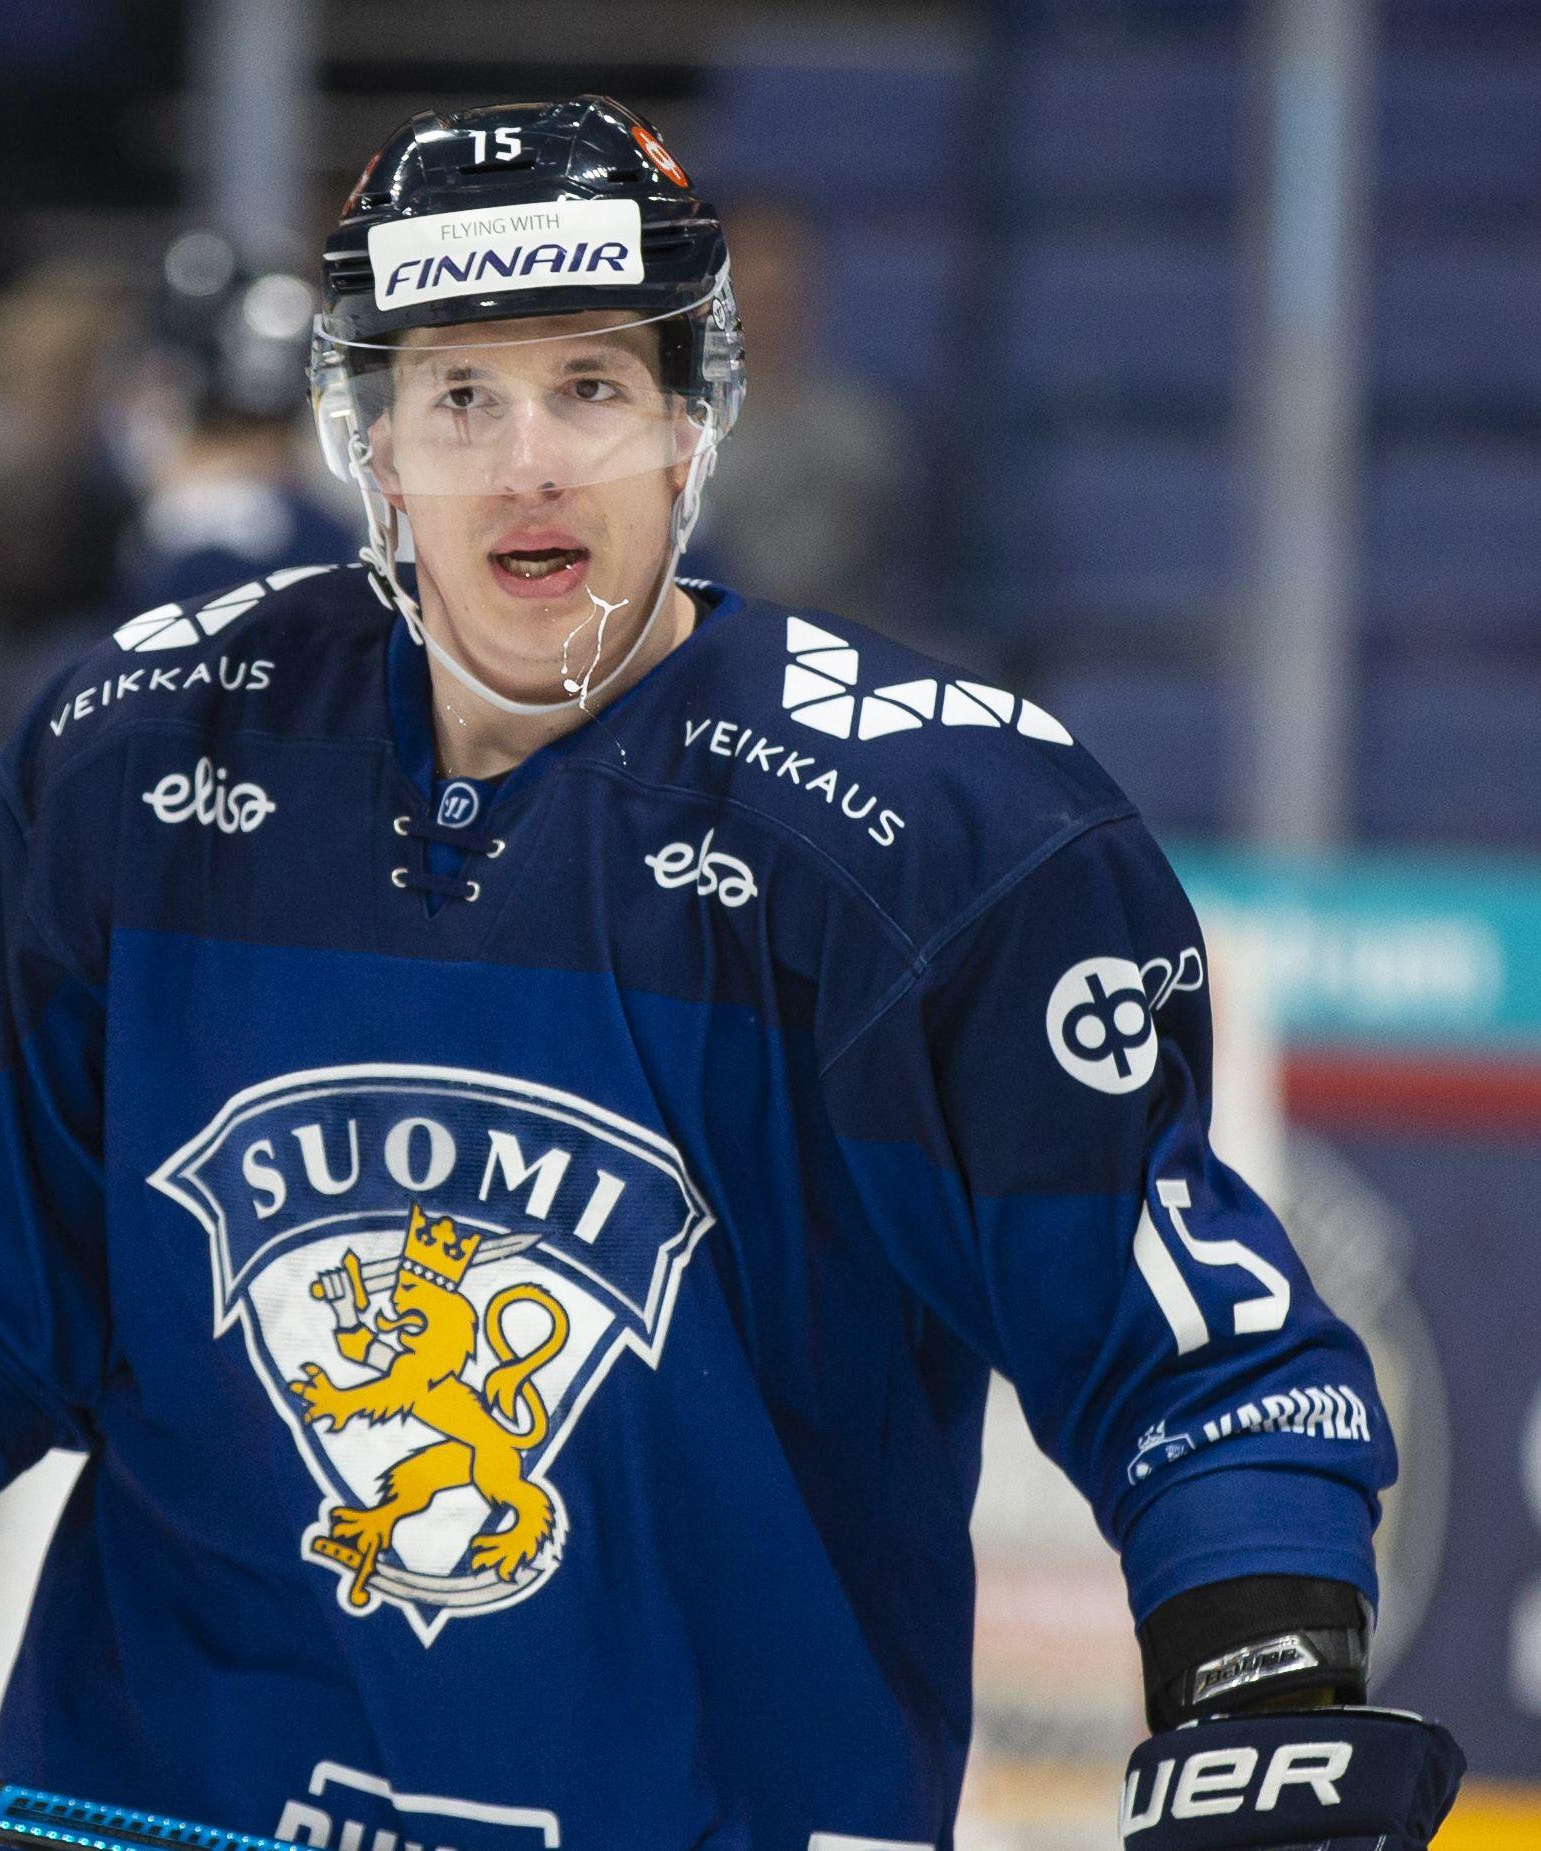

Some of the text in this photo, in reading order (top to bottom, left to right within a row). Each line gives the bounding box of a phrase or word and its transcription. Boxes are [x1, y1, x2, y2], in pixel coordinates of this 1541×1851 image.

[467, 126, 523, 164] 15
[440, 211, 560, 241] FLYING WITH
[385, 241, 629, 297] FINNAIR
[50, 655, 276, 737] VEIKKAUS
[142, 756, 276, 834] elisa
[684, 717, 905, 847] VEIKKAUS
[242, 1116, 626, 1245] SUOMI
[1132, 1178, 1291, 1357] 15
